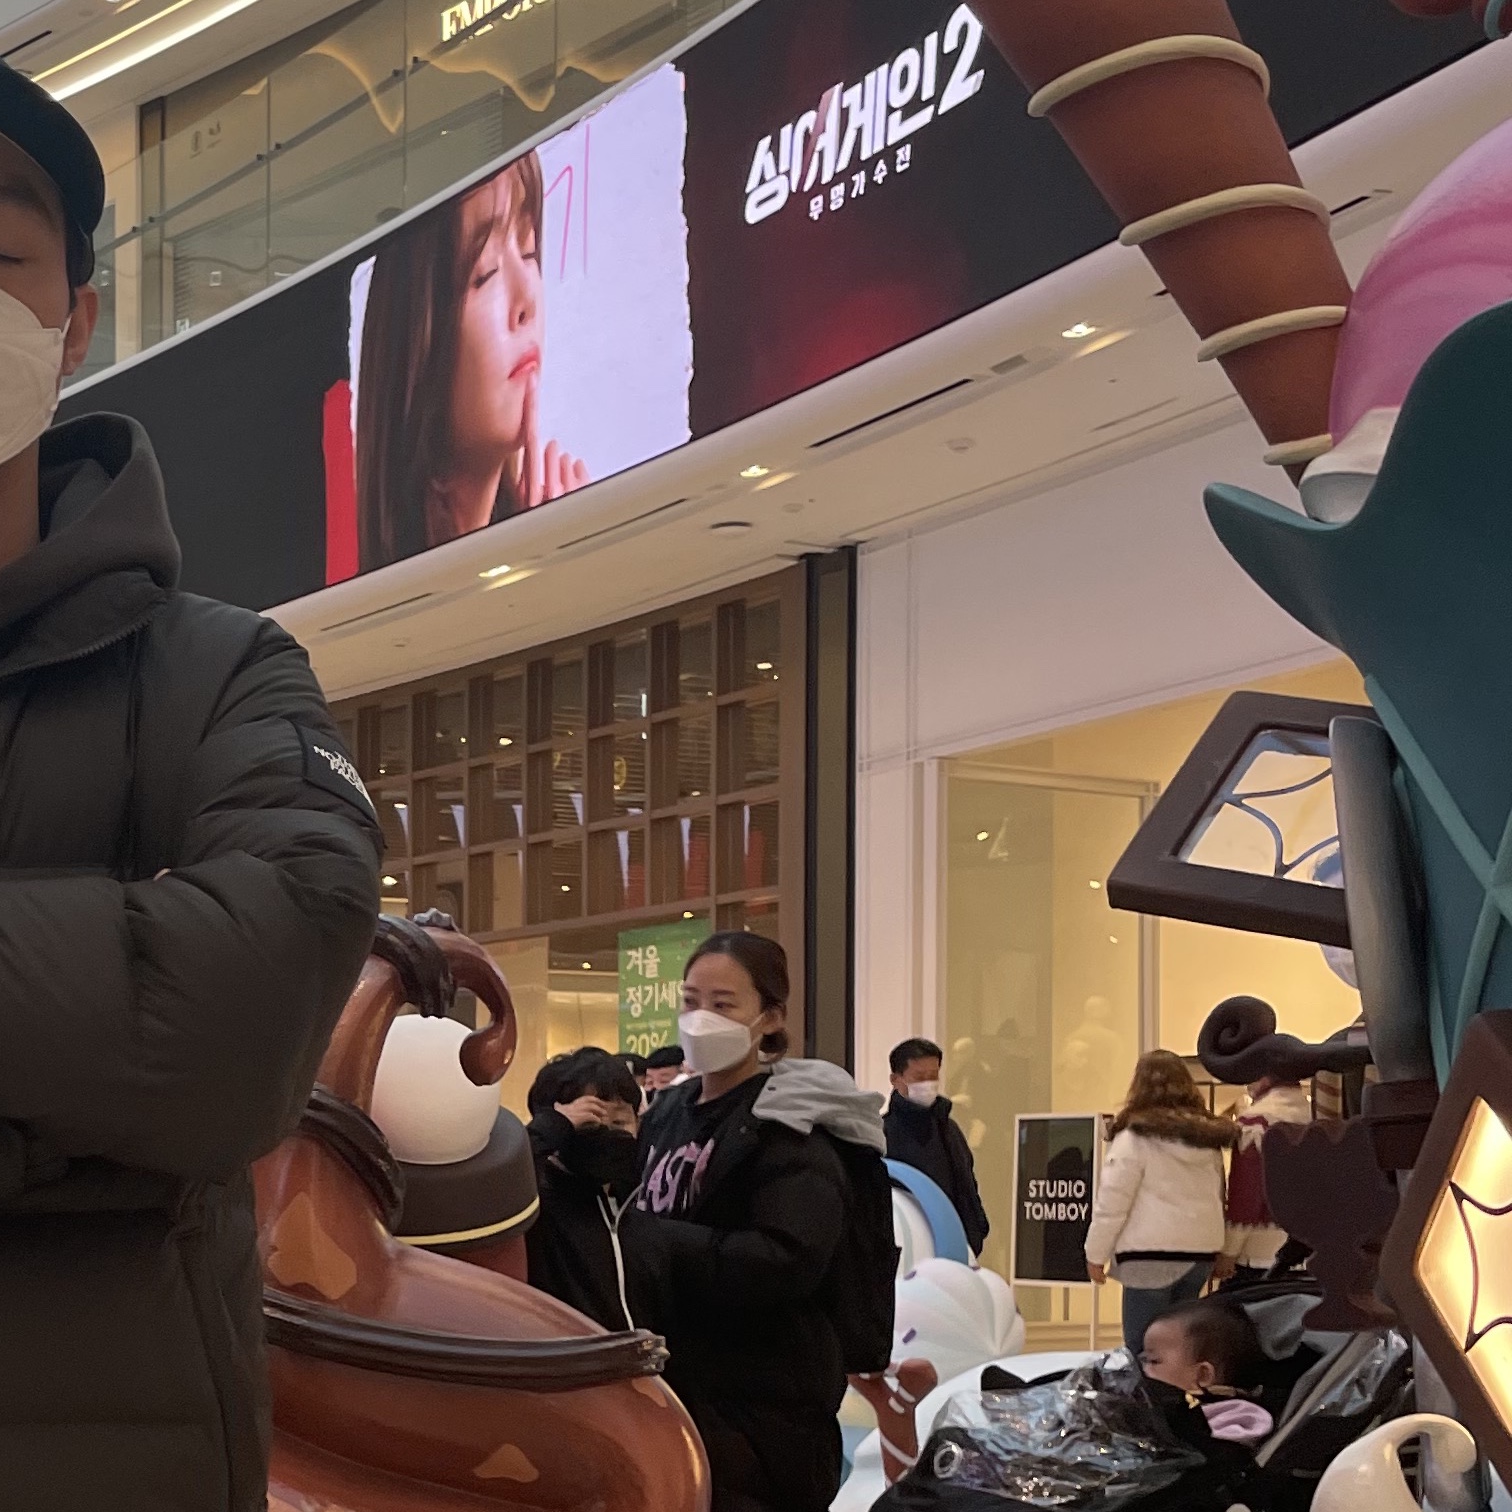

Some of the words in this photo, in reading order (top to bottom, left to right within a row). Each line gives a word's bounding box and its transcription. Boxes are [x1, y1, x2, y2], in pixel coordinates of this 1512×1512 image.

[744, 3, 985, 225] 싱어게인2
[626, 945, 661, 978] 겨울
[1028, 1179, 1086, 1198] STUDIO
[1023, 1201, 1089, 1221] TOMBOY
